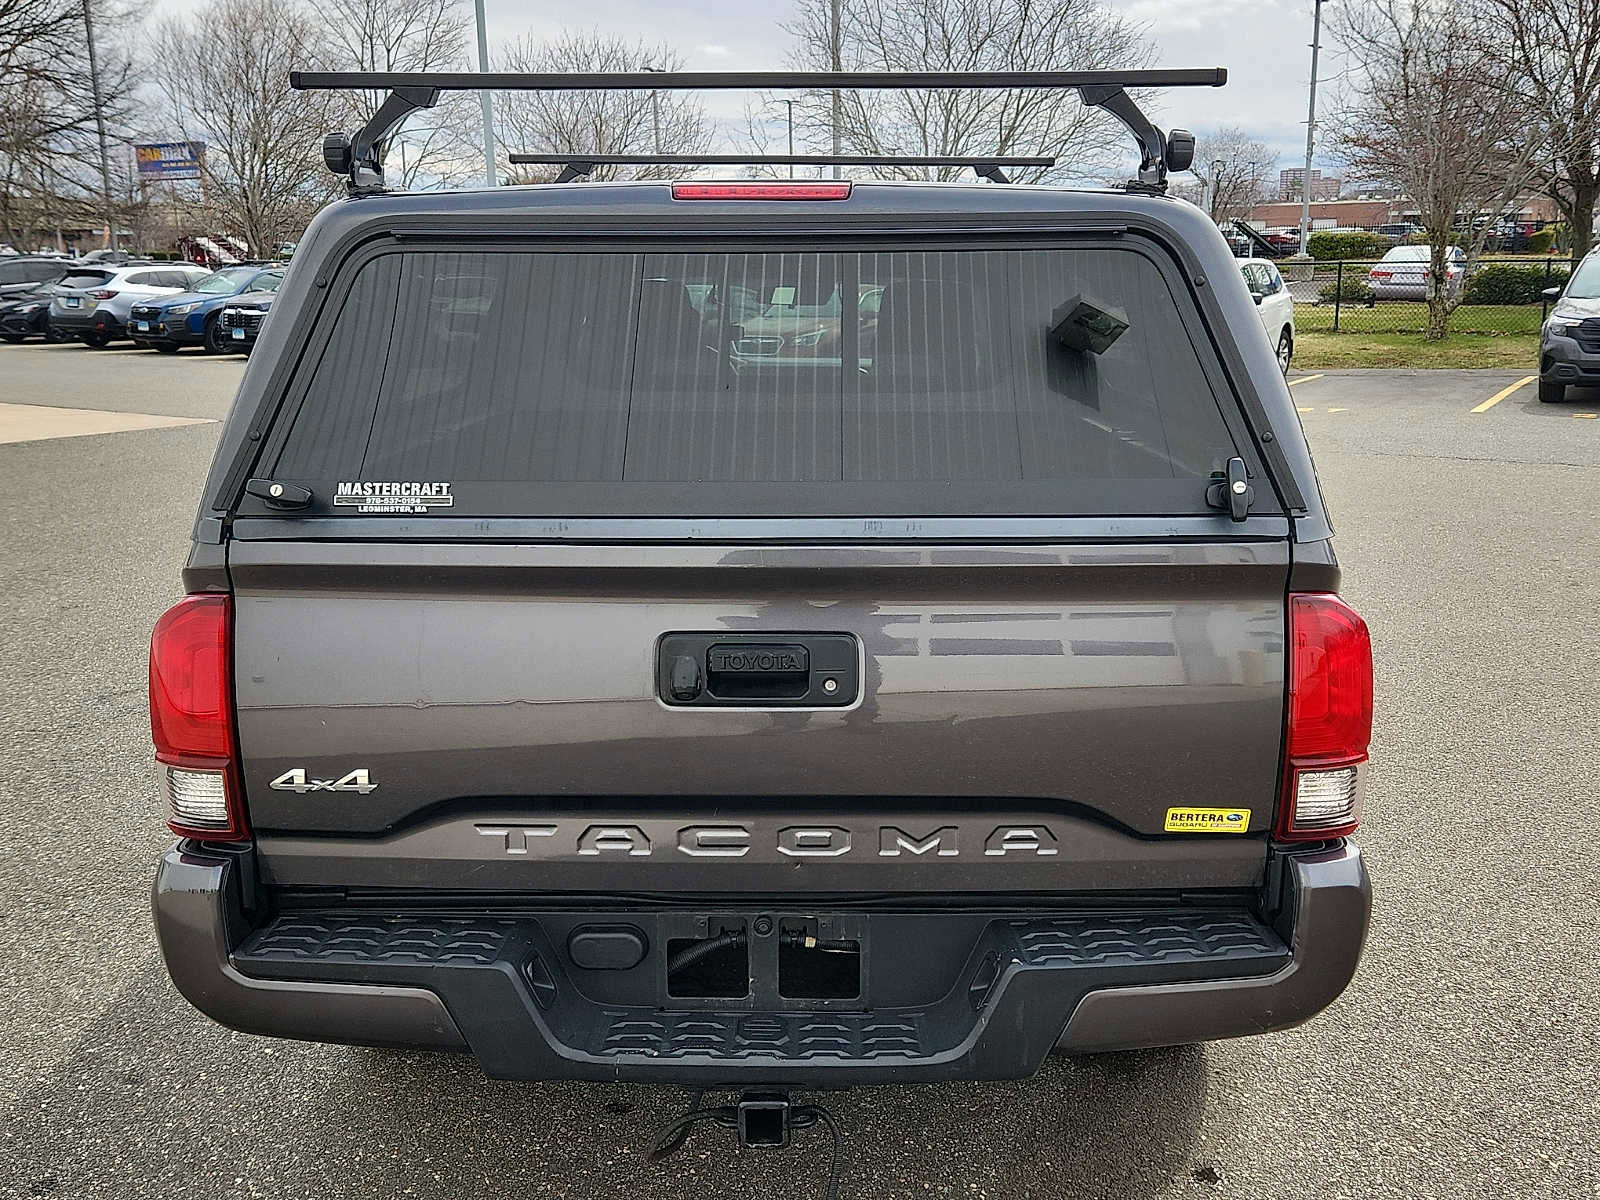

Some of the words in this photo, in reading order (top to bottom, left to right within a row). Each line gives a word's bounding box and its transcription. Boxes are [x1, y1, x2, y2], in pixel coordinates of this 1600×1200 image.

[337, 482, 450, 496] MASTERCRAFT
[415, 505, 427, 513] MA
[719, 655, 801, 670] TOYOTA
[1171, 813, 1224, 821] BERTERA
[474, 823, 1059, 856] TACOMA
